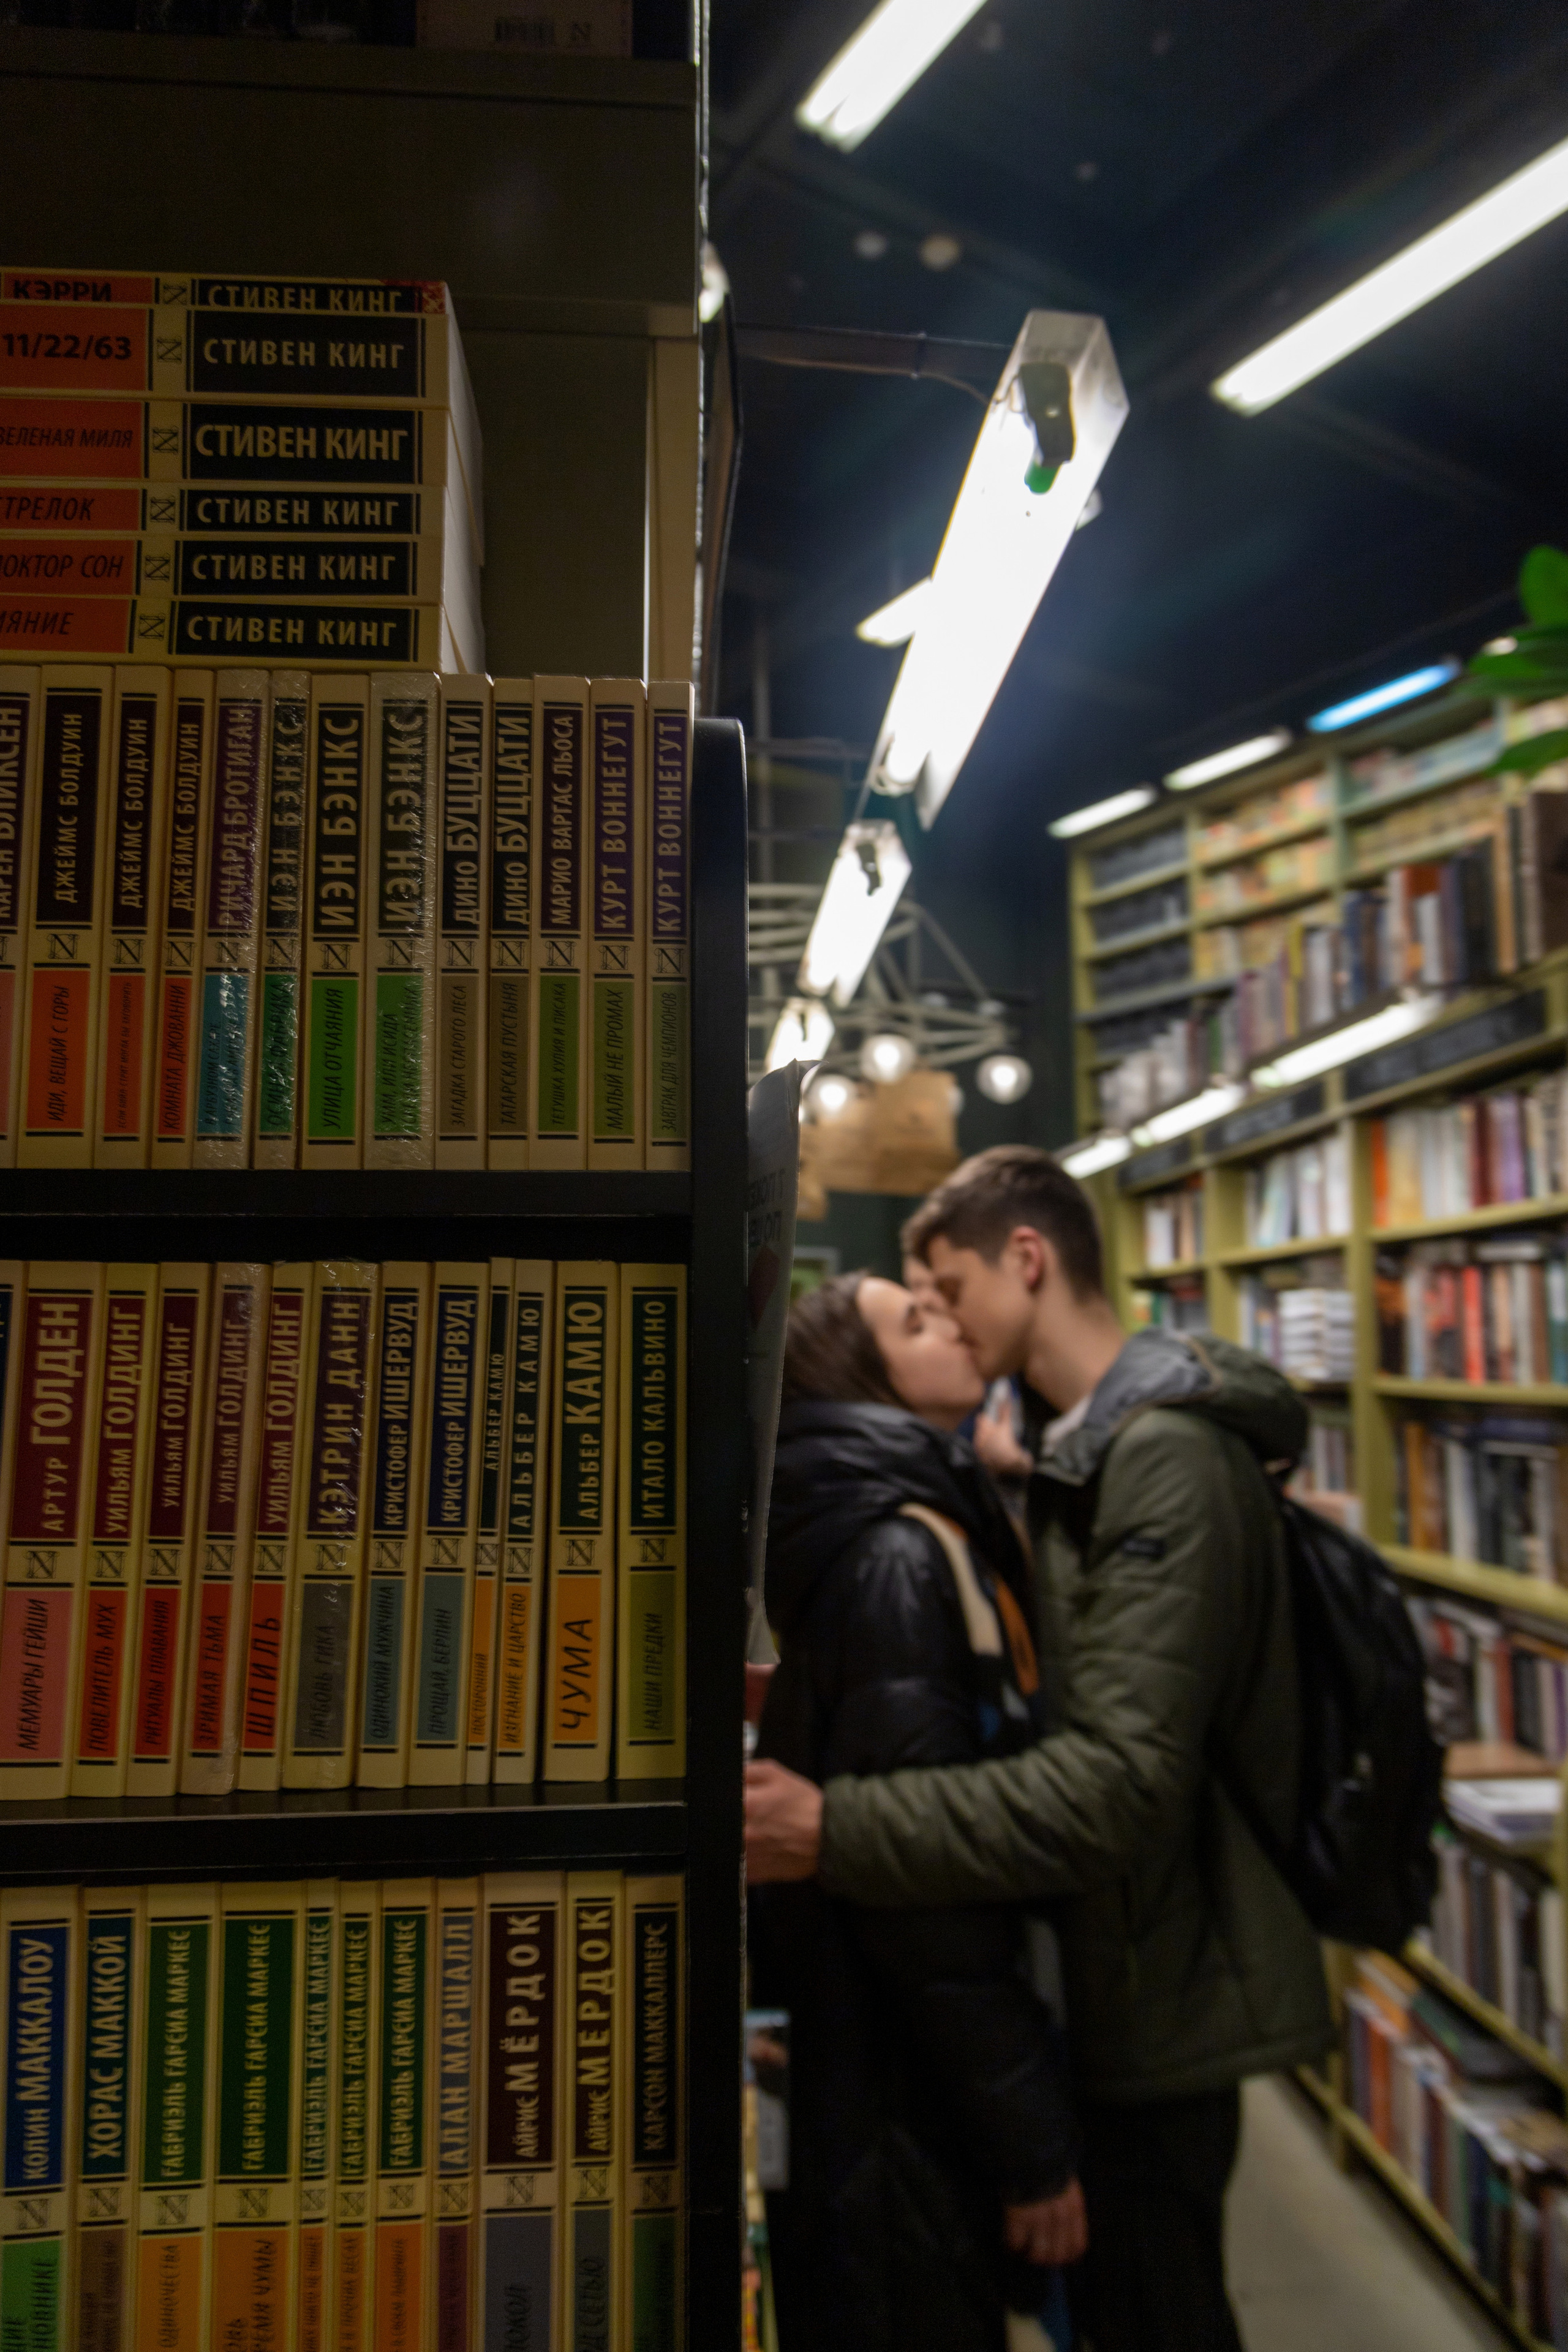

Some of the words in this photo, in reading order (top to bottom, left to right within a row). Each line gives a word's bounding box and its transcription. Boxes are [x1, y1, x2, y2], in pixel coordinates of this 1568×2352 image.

[13, 280, 112, 302] КЭРРИ
[208, 284, 316, 310] СТИВЕН
[329, 286, 402, 313] КИНГ
[1, 334, 132, 360] 11/22/63
[203, 339, 316, 366] СТИВЕН
[329, 340, 405, 369] КИНГ
[80, 429, 133, 448] МИЛЯ
[195, 424, 317, 459] СТИВЕН
[325, 427, 409, 461] КИНГ
[197, 497, 310, 525] СТИВЕН
[323, 500, 400, 526] КИНГ
[80, 556, 124, 578] СОН
[192, 554, 306, 581] СТИВЕН
[319, 556, 396, 582] КИНГ
[187, 616, 305, 644] СТИВЕН
[318, 619, 397, 646] КИНГ
[59, 714, 84, 806] БОЛДУИН
[125, 719, 148, 811] БОЛДУИН
[175, 723, 200, 815] БОЛДУИН
[223, 709, 252, 825] БРОТИГАН
[274, 722, 302, 826] БЭНКС
[323, 718, 359, 835] БЭНКС
[387, 714, 424, 831] БЭНКС
[447, 715, 482, 851] БУЦЦАТИ
[554, 717, 573, 777] ЛЬОСА
[496, 717, 531, 852] БУЦЦАТИ
[553, 782, 573, 850] ВАРГАС
[603, 718, 627, 853] ВОННЕГУТ
[658, 722, 682, 856] ВОННЕГУТ
[53, 816, 78, 903] ДЖЕЙМС
[119, 820, 143, 908] ДЖЕЙМС
[171, 824, 195, 911] ДЖЕЙМС
[217, 831, 249, 927] РИЧАРД
[270, 849, 298, 911] ИЭН
[321, 854, 356, 925] ИЭН
[385, 850, 421, 922] ИЭН
[455, 861, 480, 924] ДИНО
[503, 861, 529, 925] ДИНО
[552, 857, 571, 924] МАРИО
[603, 865, 626, 928] КУРТ
[658, 869, 680, 931] КУРТ
[53, 986, 70, 1022] ГОРЫ
[166, 985, 186, 1063] ДЖОВАННИ
[323, 988, 344, 1071] ОТЧАЯНИЯ
[383, 1013, 399, 1054] ИСИДА
[453, 986, 466, 1014] ЛЕСА
[502, 984, 518, 1047] ПУСТЫНЯ
[554, 983, 566, 1023] ПИСАКА
[606, 989, 624, 1049] ПРОМАХ
[662, 992, 677, 1058] ЧЕМПИОНОВ
[49, 1038, 69, 1085] ВЕЩАЙ
[452, 1019, 466, 1069] СТАРОГО
[553, 1038, 565, 1074] ХУЛИЯ
[606, 1052, 623, 1071] НЕ
[662, 1062, 679, 1085] ДЛЯ
[48, 1090, 67, 1121] ИДИ,
[163, 1068, 182, 1129] КОМНАТА
[323, 1076, 344, 1129] УЛИЦА
[452, 1074, 469, 1125] ЗАГАДКА
[501, 1053, 517, 1125] ТАТАРСКАЯ
[551, 1077, 565, 1125] ТЕТУШКА
[603, 1073, 624, 1129] МАЛЫЙ
[661, 1087, 677, 1131] ЗАВТРАК
[31, 1302, 84, 1444] ГОЛДЕН
[104, 1305, 142, 1439] ГОЛДИНГ
[160, 1322, 192, 1430] ГОЛДИНГ
[217, 1319, 248, 1426] ГОЛДИНГ
[266, 1303, 300, 1431] ГОЛДИНГ
[327, 1302, 361, 1389] ДАНН
[382, 1302, 418, 1419] ИШЕРВУД
[440, 1299, 476, 1417] ИШЕРВУД
[488, 1353, 504, 1400] КАМЮ
[518, 1308, 540, 1393] КАМЮ
[564, 1302, 603, 1424] КАМЮ
[643, 1301, 666, 1431] КАЛЬВИНО
[162, 1438, 183, 1507] УИЛЬЯМ
[217, 1433, 239, 1503] УИЛЬЯМ
[318, 1403, 354, 1524] КЭТРИН
[383, 1425, 407, 1525] КРИСТОФЕР
[441, 1422, 465, 1521] КРИСТОФЕР
[484, 1409, 500, 1470] АЛЬБЕР
[511, 1412, 534, 1528] АЛЬБЕР
[41, 1457, 69, 1531] АРТУР
[105, 1449, 131, 1532] УИЛЬЯМ
[266, 1441, 292, 1524] УИЛЬЯМ
[578, 1433, 600, 1520] АЛЬБЕР
[642, 1441, 666, 1519] ИТАЛО
[20, 1599, 48, 1658] ГЕЙШИ
[94, 1604, 116, 1640] МУХ
[149, 1600, 169, 1675] ПЛАВАНИЯ
[203, 1615, 225, 1662] ТЬМА
[375, 1586, 394, 1657] МУЖЧИНА
[434, 1608, 452, 1665] БЕРЛИН
[508, 1594, 527, 1653] ЦАРСТВО
[644, 1613, 665, 1676] ПРЕДКИ
[89, 1646, 114, 1751] ПОВЕЛИТЕЛЬ
[246, 1618, 281, 1736] ШПИЛЬ
[509, 1658, 522, 1668] И
[560, 1619, 592, 1729] ЧУМА
[15, 1662, 44, 1751] МЕМУАРЫ
[145, 1680, 164, 1745] РИТУАЛЫ
[198, 1672, 220, 1744] ЗРИМАЯ
[309, 1673, 333, 1739] ЛЮБОВЬ
[369, 1662, 391, 1738] ОДИНОКИЙ
[503, 1673, 522, 1743] ИЗГНАНИЕ
[644, 1681, 662, 1730] НАШИ
[166, 1931, 191, 2003] МАРКЕС
[247, 1924, 271, 1997] МАРКЕС
[344, 1929, 368, 2002] МАРКЕС
[393, 1920, 417, 1993] МАРКЕС
[645, 1922, 668, 2063] МАККАЛЛЕРС
[16, 1938, 54, 2101] МАККАЛОУ
[88, 1936, 126, 2058] МАККОЙ
[391, 1997, 416, 2066] ГАРСИА
[440, 1924, 472, 2073] МАРШАЛЛ
[499, 1913, 545, 2092] МЁРДОК
[577, 1909, 615, 2086] МЕРДОК
[164, 2008, 188, 2076] ГАРСИА
[244, 2002, 268, 2070] ГАРСИА
[342, 2007, 366, 2075] ГАРСИА
[23, 2108, 50, 2179] КОЛИН
[88, 2067, 123, 2158] ХОРАС
[160, 2082, 186, 2176] ГАБРИЭЛЬ
[242, 2076, 267, 2170] ГАБРИЭЛЬ
[341, 2080, 365, 2173] ГАБРИЭЛЬ
[390, 2070, 414, 2166] ГАБРИЭЛЬ
[439, 2087, 470, 2164] АЛАН
[512, 2096, 539, 2157] АЙРИС
[584, 2088, 611, 2151] АЙРИС
[644, 2068, 668, 2150] КАРСОН
